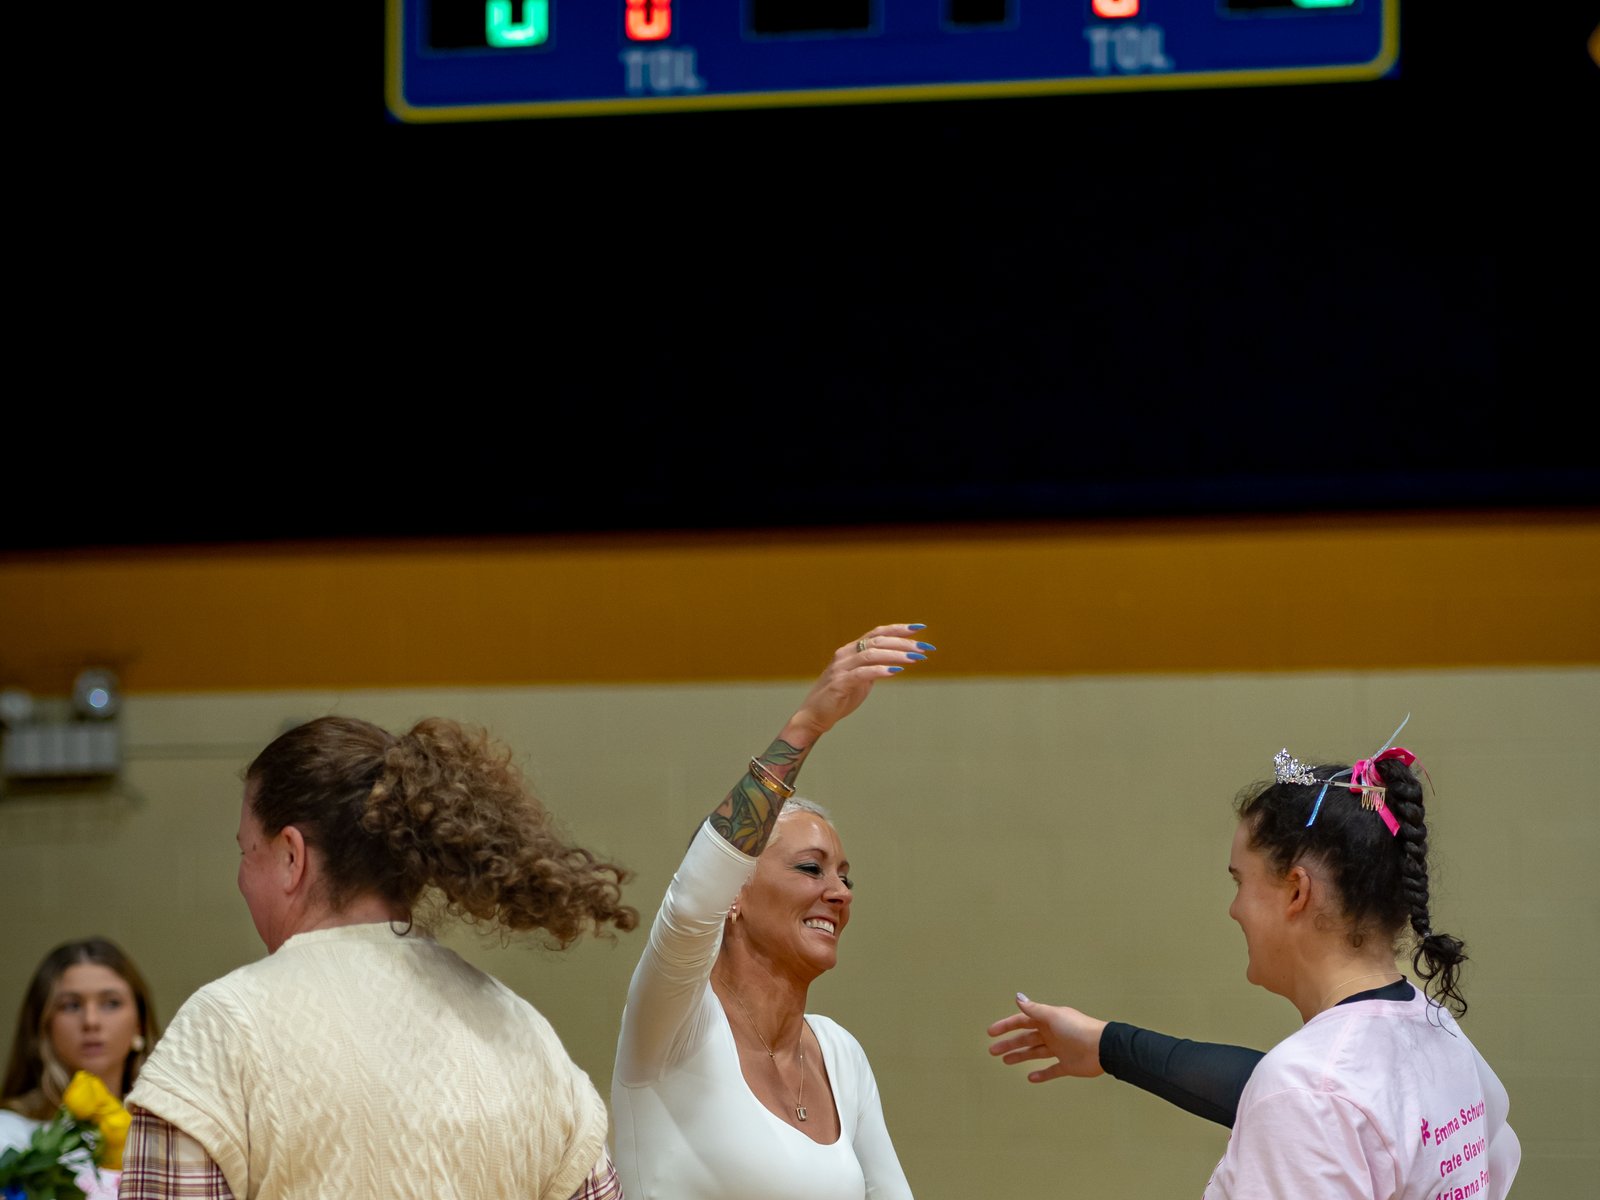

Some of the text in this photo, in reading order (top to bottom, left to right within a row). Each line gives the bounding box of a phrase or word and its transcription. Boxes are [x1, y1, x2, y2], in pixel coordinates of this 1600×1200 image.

[1085, 27, 1173, 71] TOL
[621, 49, 702, 94] TOL
[1434, 1117, 1460, 1146] Emma
[1440, 1153, 1462, 1178] Cate
